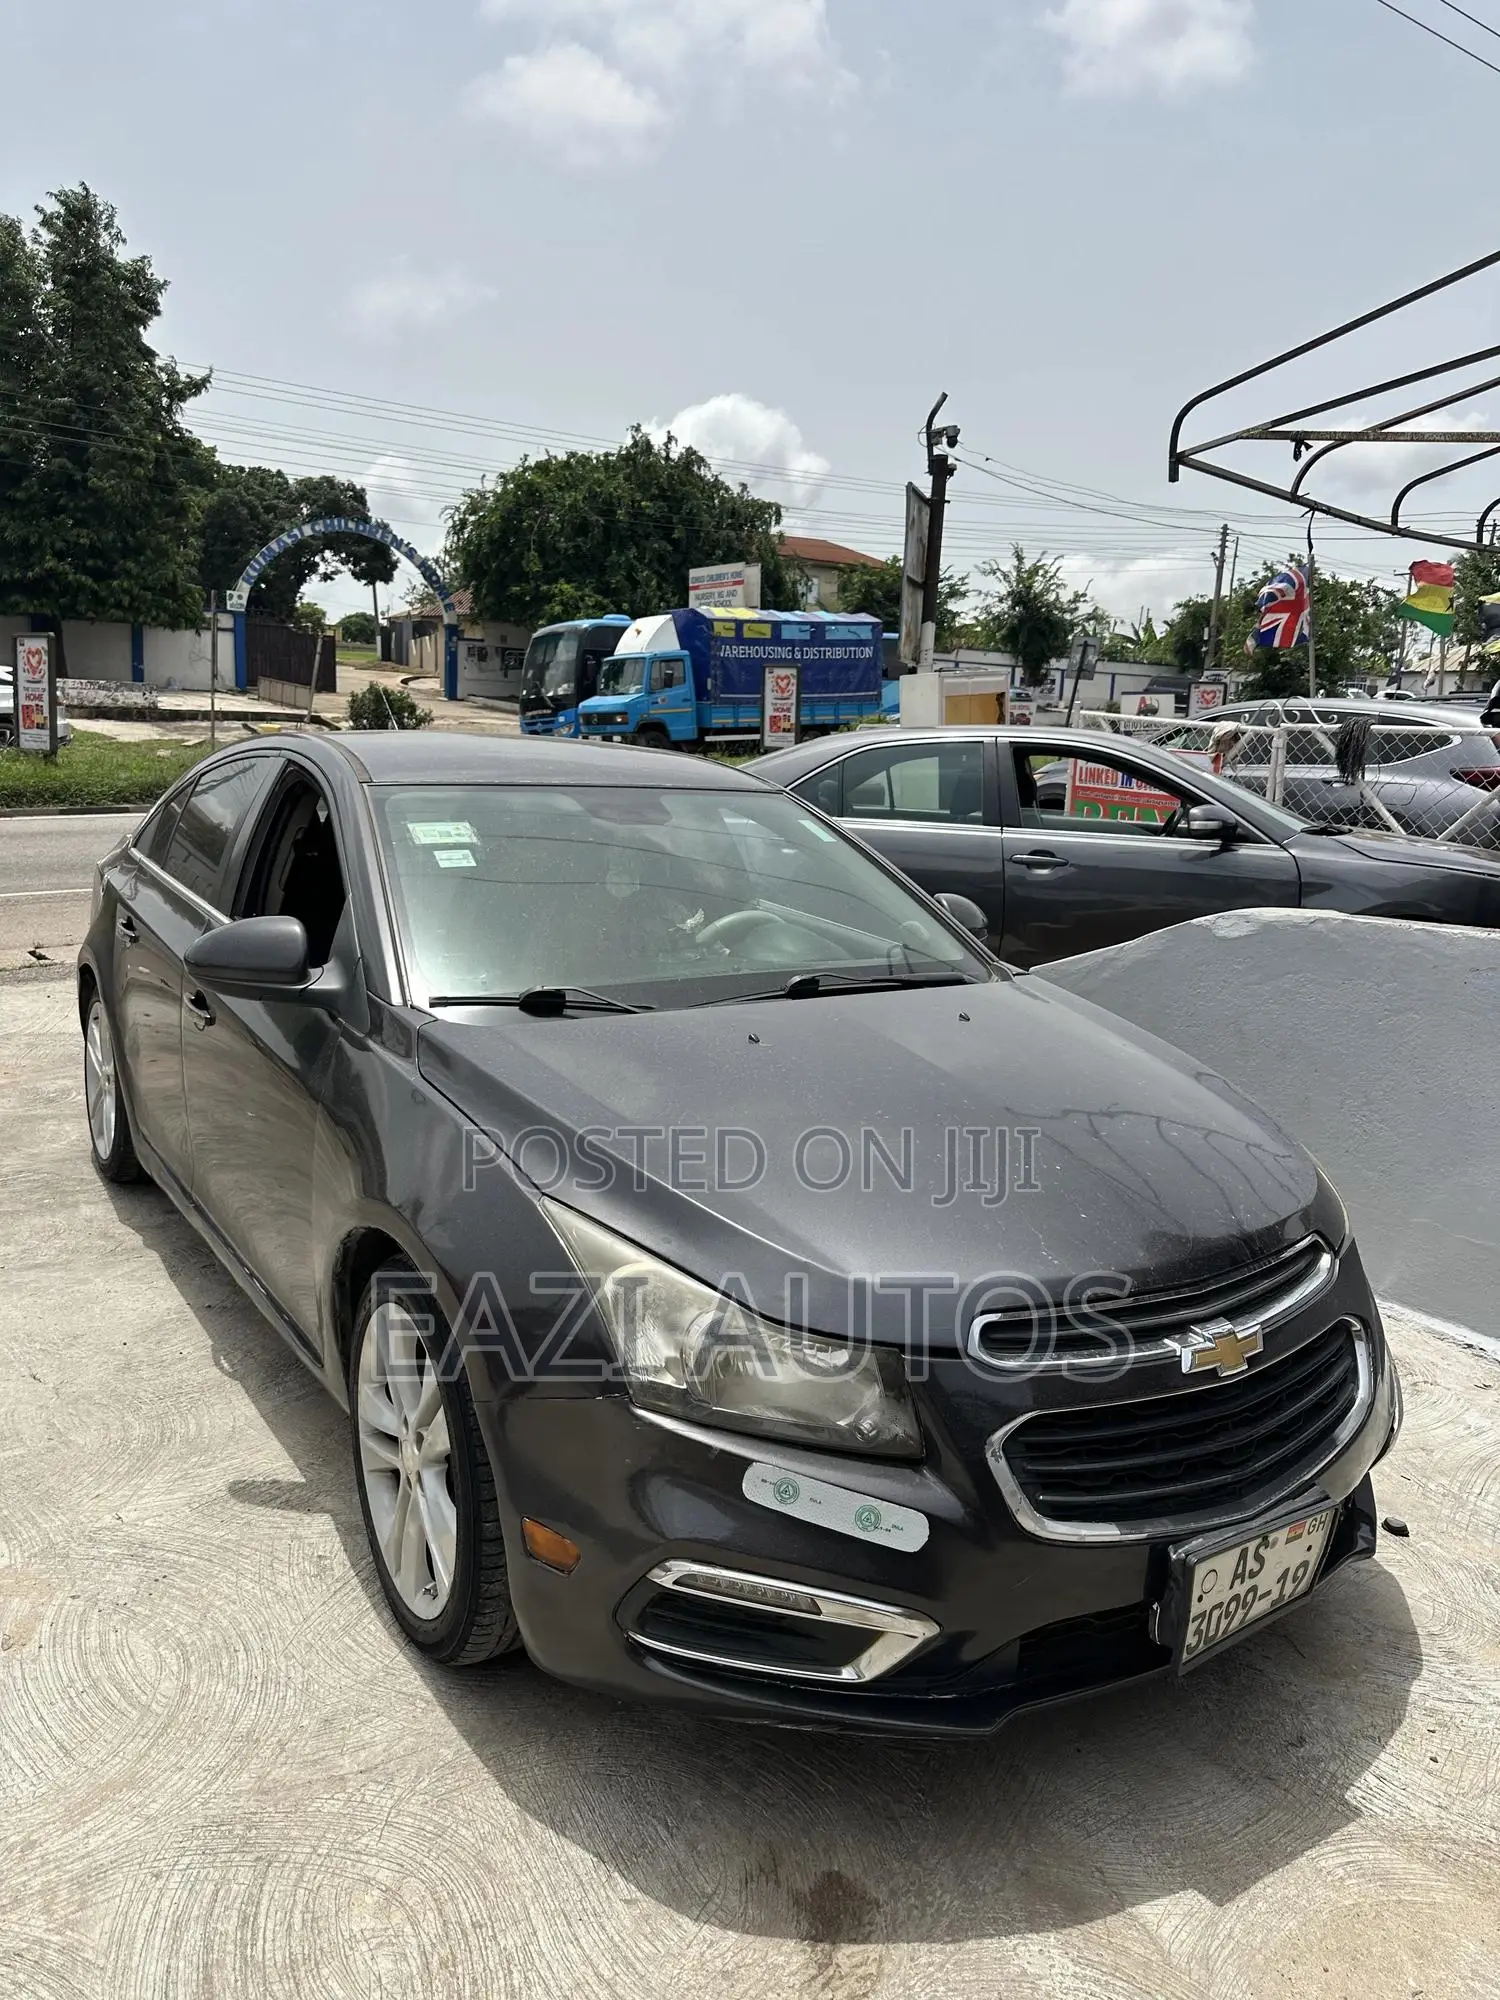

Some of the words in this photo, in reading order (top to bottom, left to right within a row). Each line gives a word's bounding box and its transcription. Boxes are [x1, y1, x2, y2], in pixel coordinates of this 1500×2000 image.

[242, 527, 305, 587] KUMASI
[794, 647, 801, 659] &
[803, 646, 874, 660] DISTRIBUTION
[25, 692, 45, 702] HOME
[1079, 765, 1118, 787] LINKED
[1119, 772, 1134, 789] IN
[1229, 1539, 1270, 1590] AS
[1307, 1512, 1328, 1536] GH
[1186, 1559, 1311, 1656] 3099-19
